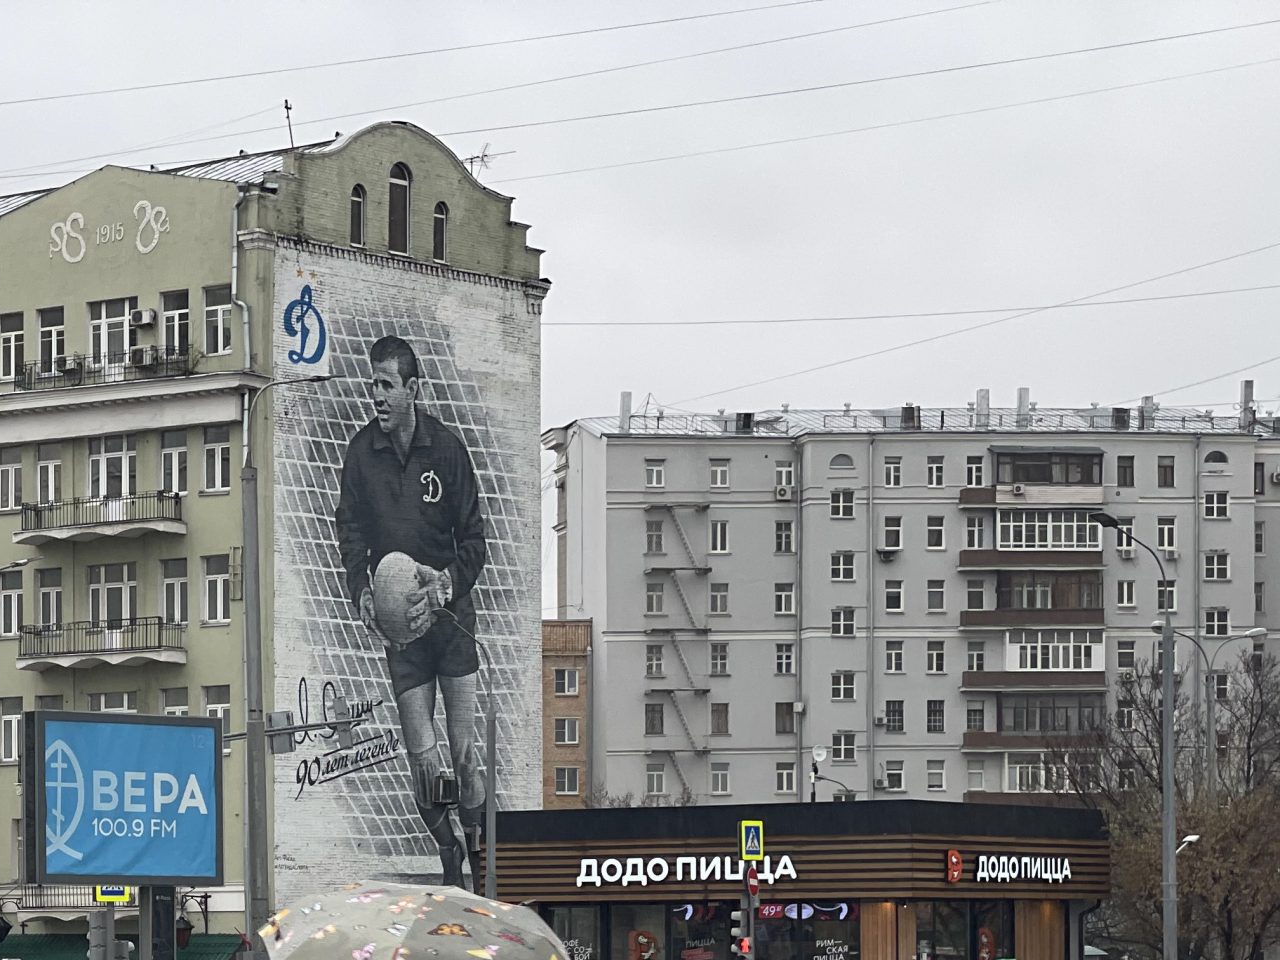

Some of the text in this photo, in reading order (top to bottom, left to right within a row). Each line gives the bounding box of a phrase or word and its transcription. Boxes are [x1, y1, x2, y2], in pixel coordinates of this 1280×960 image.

[96, 222, 124, 245] 1915
[92, 769, 208, 815] ВЕРА
[295, 757, 320, 801] 90
[321, 754, 349, 776] лет
[92, 817, 177, 839] 100.9 FM
[576, 855, 797, 887] ДОДО ПИЦЦА
[976, 855, 1072, 884] ДОДО ПИЦЦА
[826, 945, 849, 954] СКАЯ
